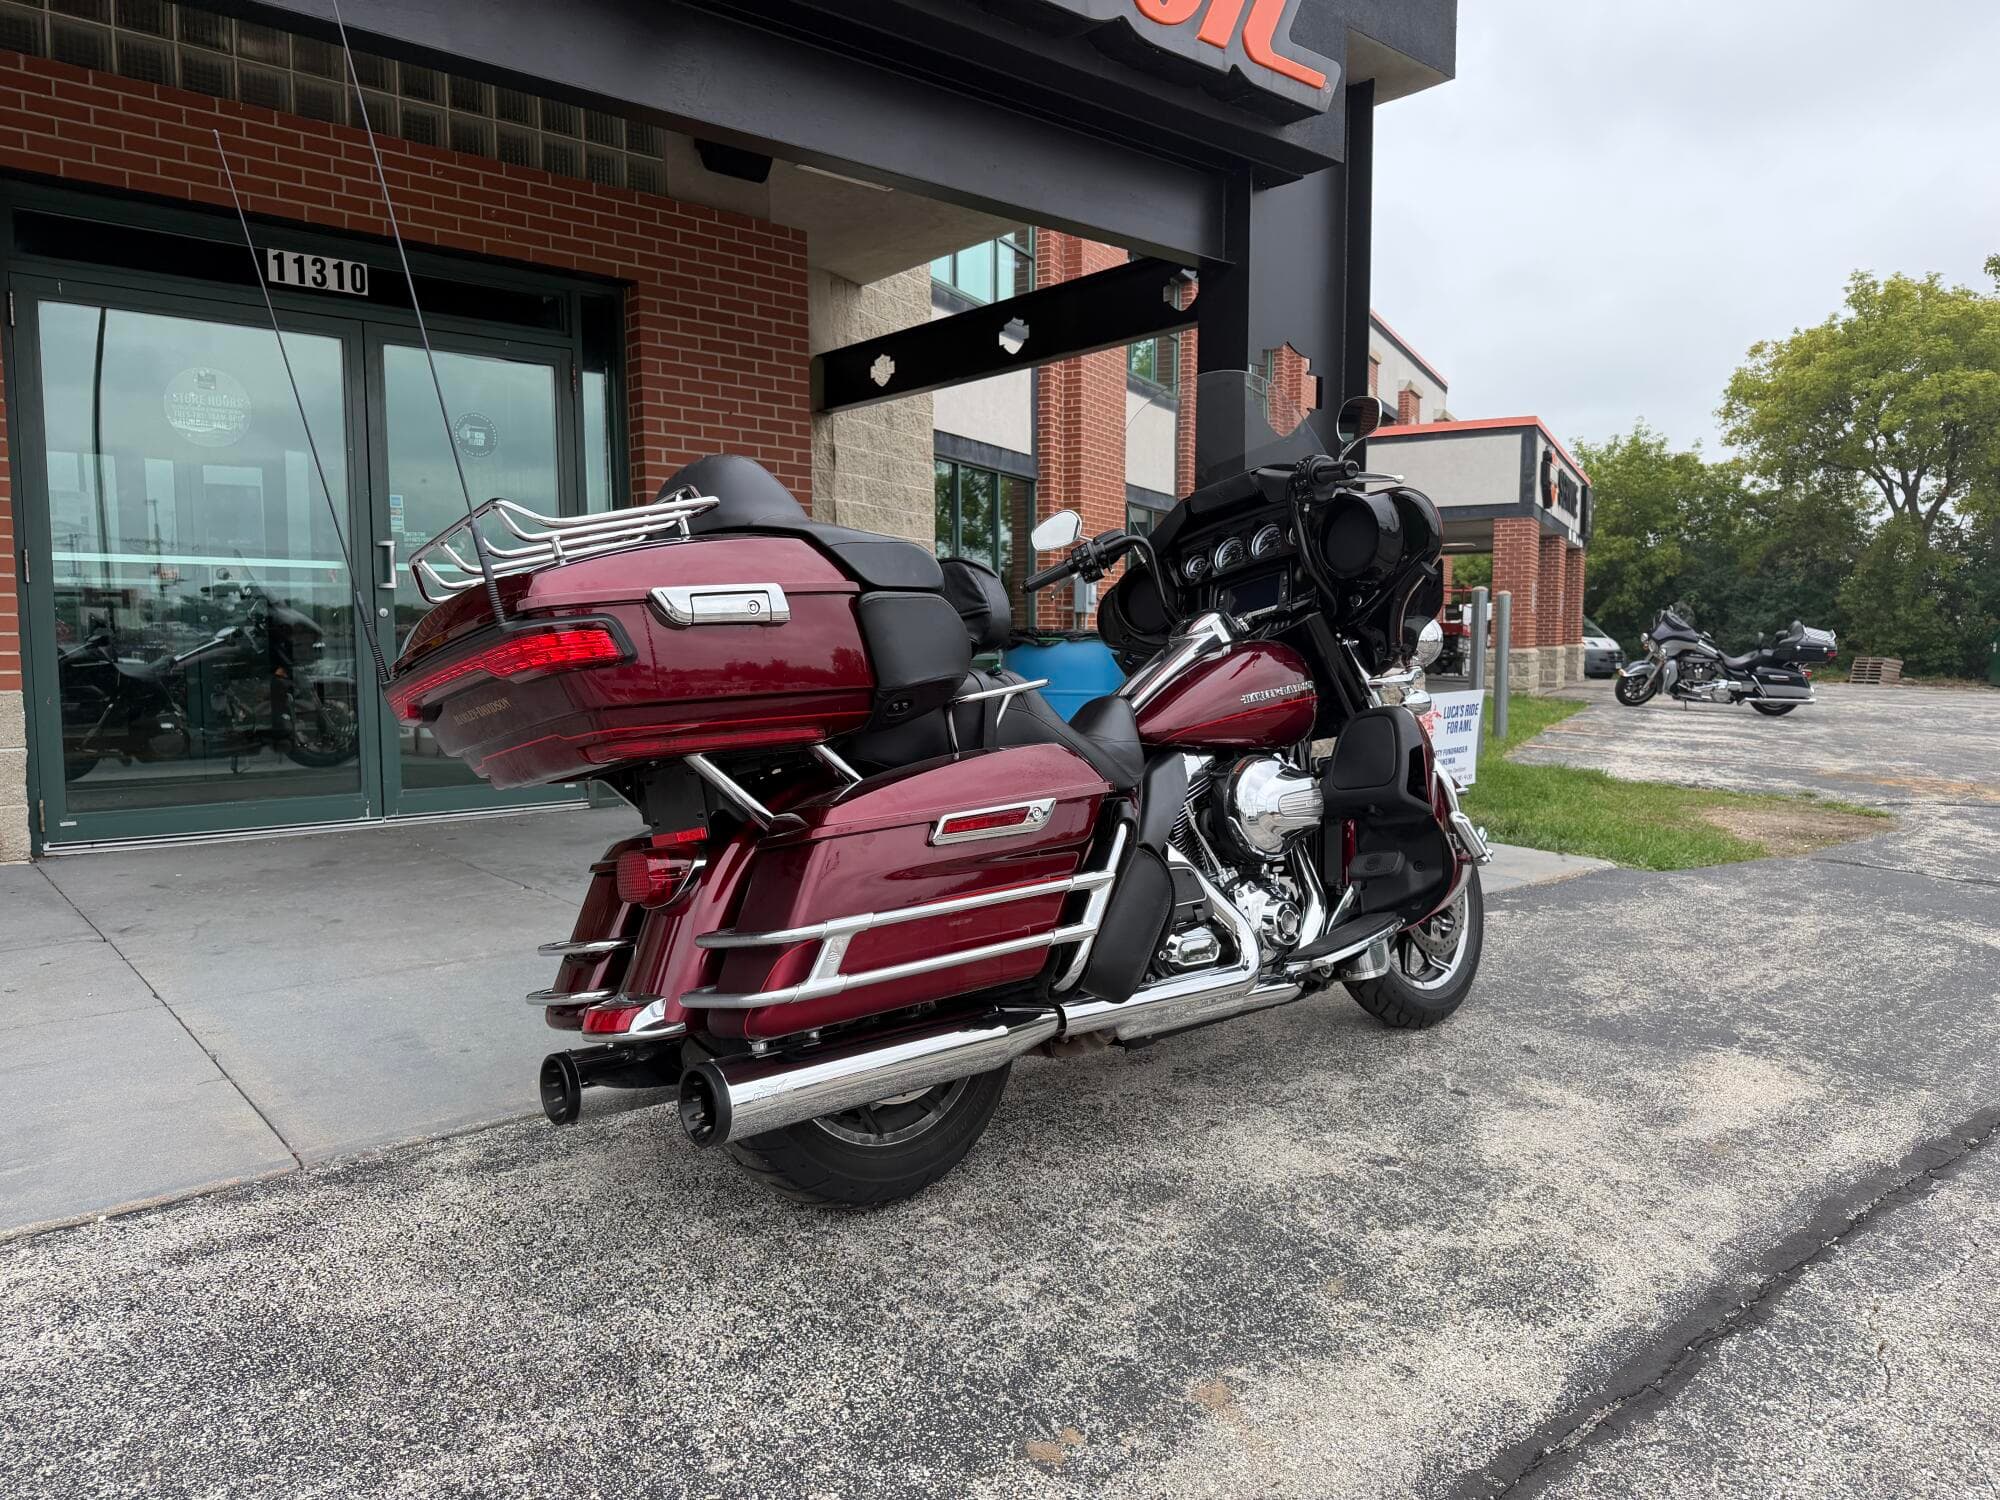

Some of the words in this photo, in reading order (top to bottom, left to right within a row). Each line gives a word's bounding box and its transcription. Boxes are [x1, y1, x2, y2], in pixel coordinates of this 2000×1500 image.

[272, 251, 366, 293] 11310
[1240, 681, 1314, 704] HARLEY-DAVIDSO
[1443, 704, 1464, 719] LUCA'S
[1464, 703, 1479, 717] RIDE
[1446, 721, 1458, 735] FOR
[1458, 720, 1472, 732] AML
